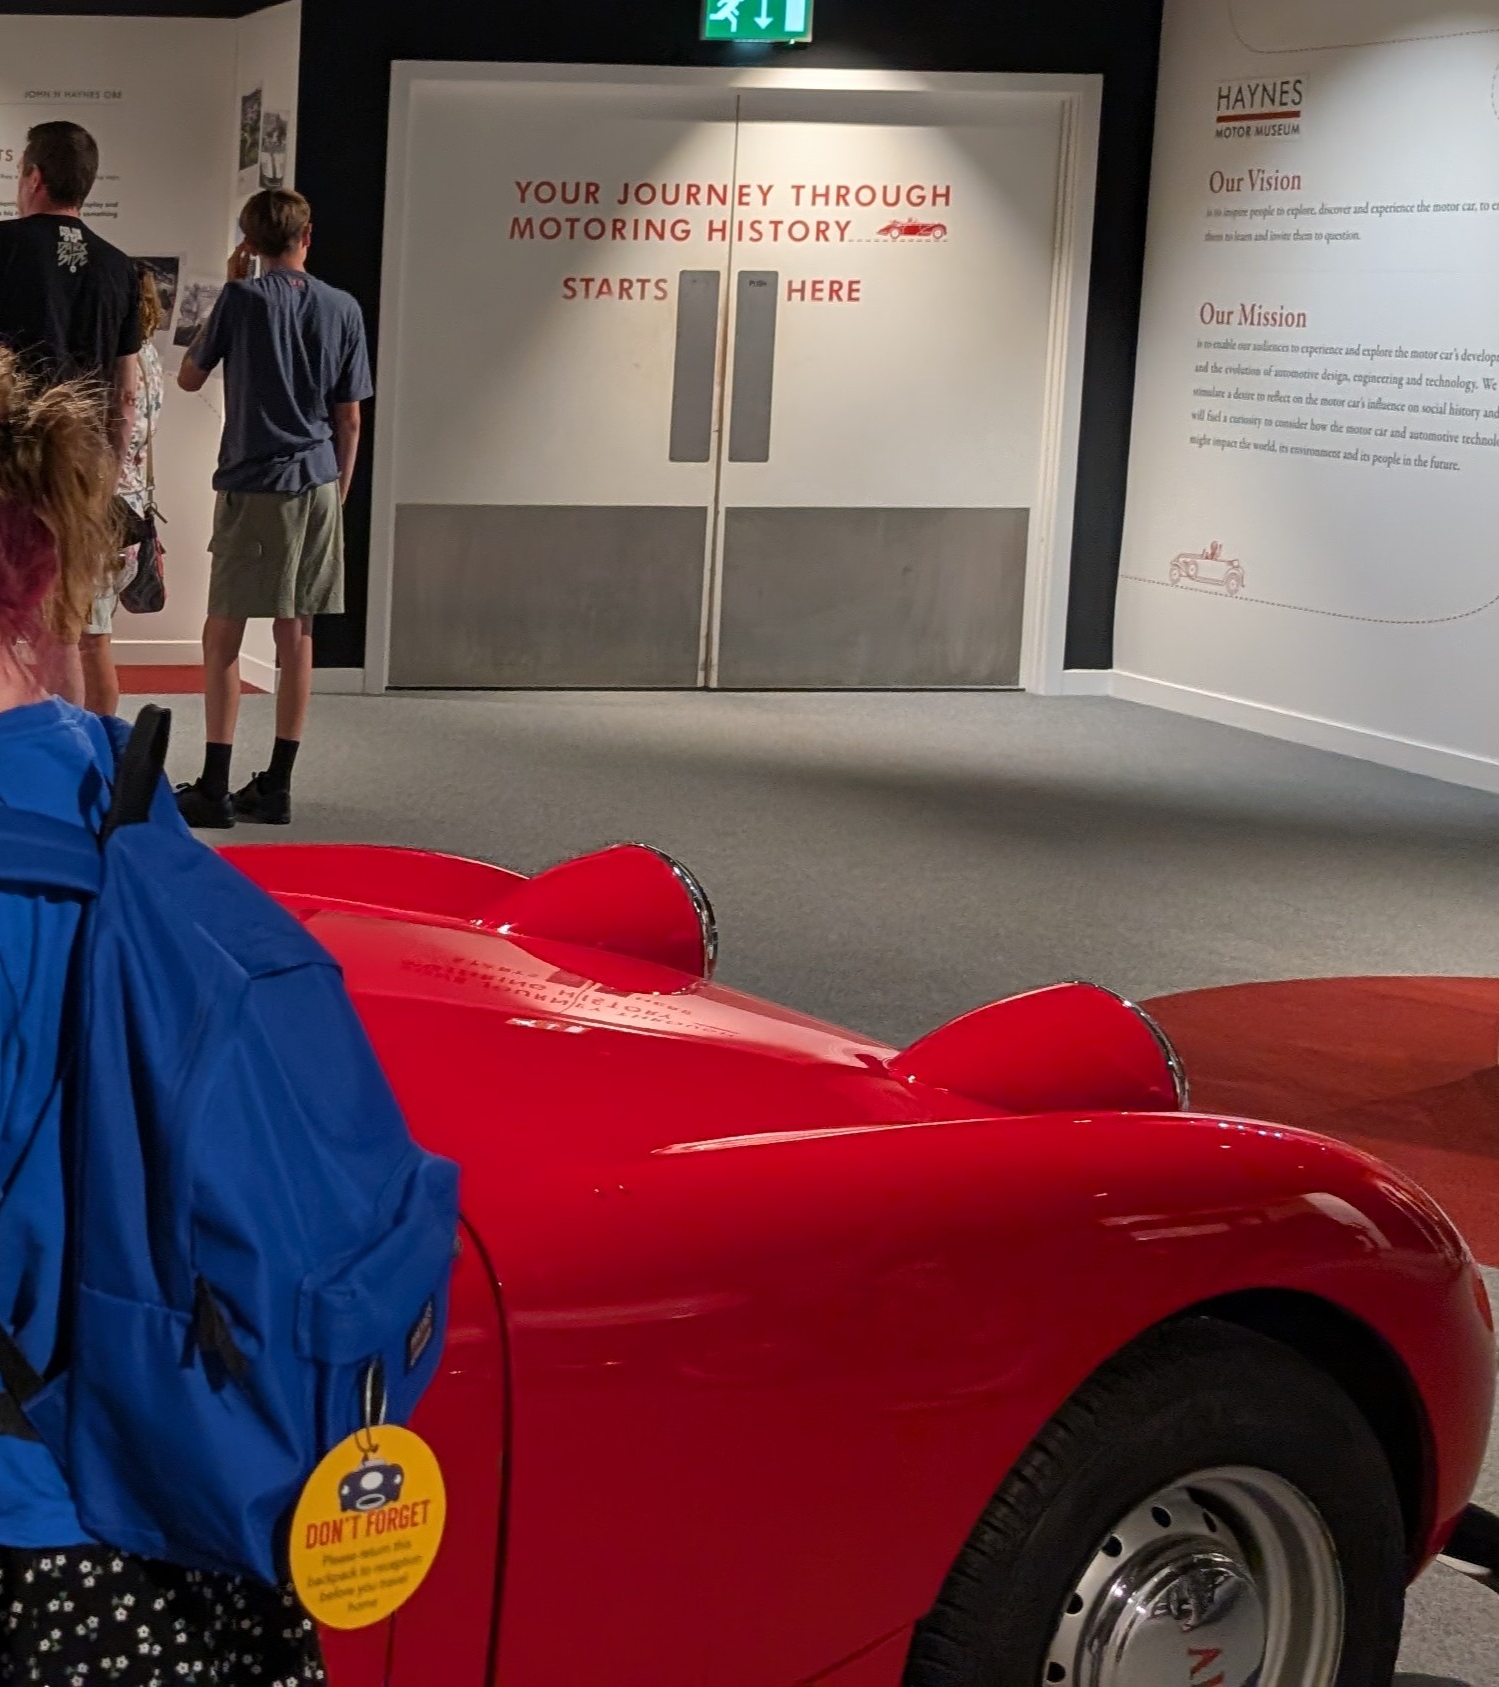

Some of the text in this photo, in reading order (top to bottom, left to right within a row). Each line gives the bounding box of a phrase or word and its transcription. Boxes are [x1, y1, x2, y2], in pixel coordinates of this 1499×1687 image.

[1217, 80, 1302, 111] HAYNES
[1215, 123, 1300, 138] MOTOR MUSEUM
[1209, 169, 1301, 193] Our Vision
[515, 181, 952, 208] YOUR JOURNEY THROUGH
[1417, 200, 1430, 212] the
[1433, 202, 1459, 212] motor
[1480, 202, 1489, 211] to
[509, 217, 851, 243] MOTORING HISTORY
[57, 241, 88, 255] DARK
[58, 253, 88, 267] SIDE
[562, 277, 861, 302] STARTS HERE
[1200, 302, 1307, 328] Our Mission
[1301, 343, 1343, 357] experience
[1345, 344, 1360, 356] and
[1362, 345, 1392, 360] explore
[1395, 346, 1409, 358] the
[1411, 349, 1437, 360] motor
[1353, 373, 1403, 389] engineering
[1406, 374, 1422, 386] and
[1426, 374, 1478, 393] technology.
[1483, 378, 1497, 391] We
[1343, 448, 1358, 461] and
[1372, 452, 1400, 468] people
[1403, 455, 1411, 465] in
[1414, 454, 1428, 468] the
[1430, 457, 1460, 470] future.
[366, 1499, 431, 1537] FORGET
[322, 1550, 356, 1566] Please
